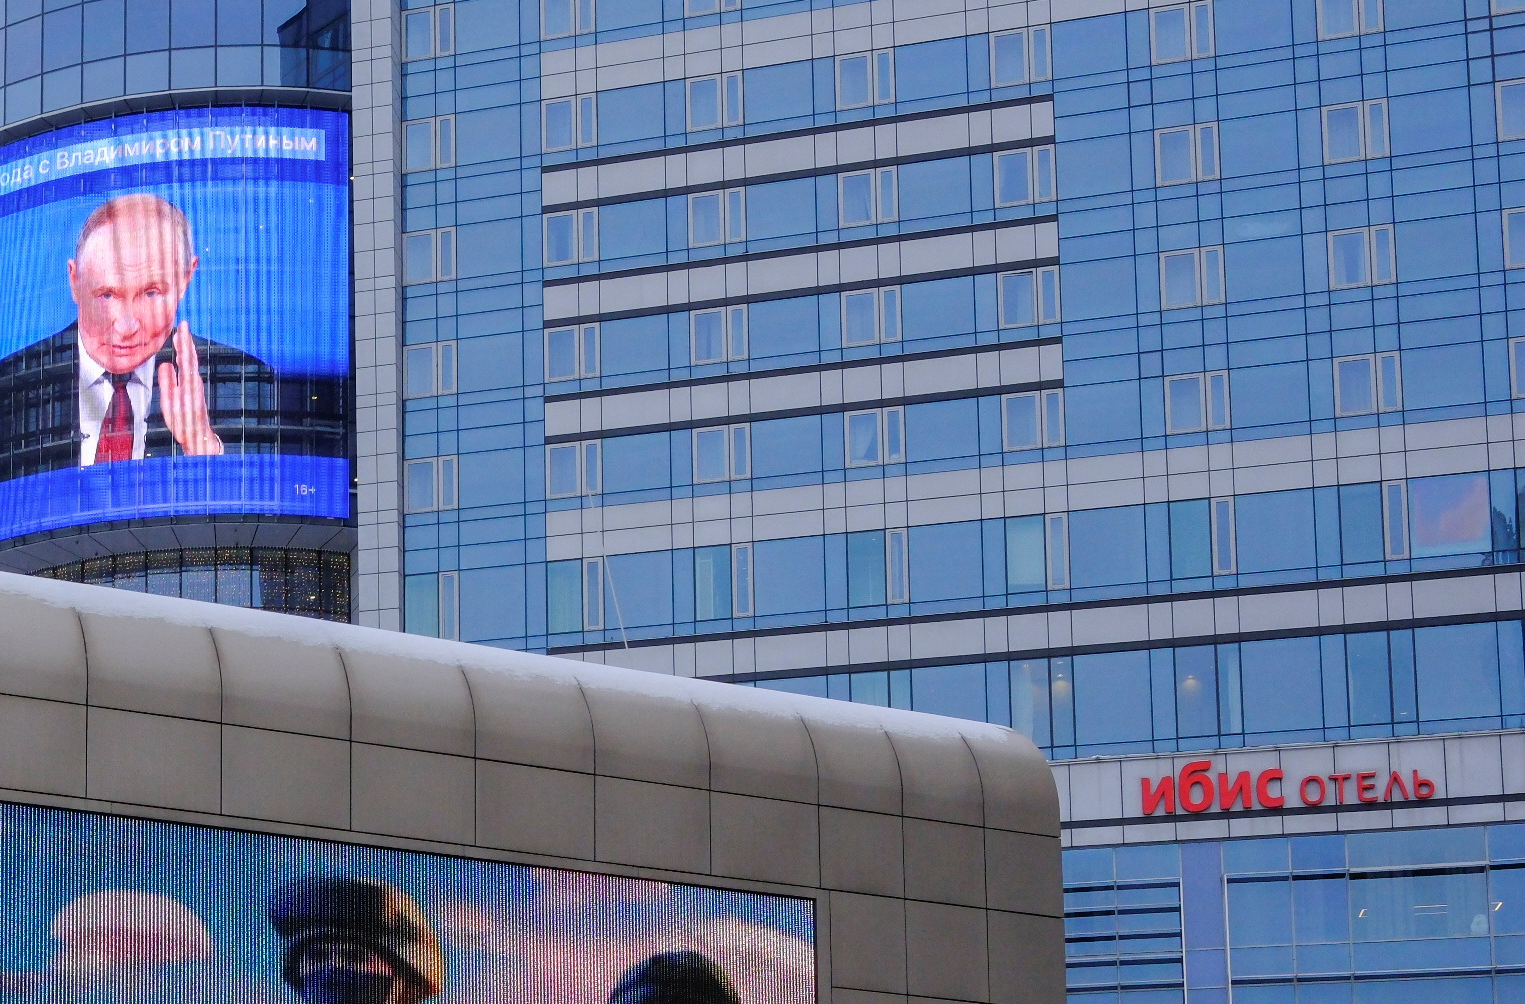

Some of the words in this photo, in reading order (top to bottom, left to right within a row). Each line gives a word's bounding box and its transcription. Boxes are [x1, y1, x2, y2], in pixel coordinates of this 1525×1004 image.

[38, 158, 50, 175] с
[56, 135, 202, 171] Владимиром
[209, 130, 318, 154] Путиным
[294, 484, 316, 496] 16+
[1141, 760, 1286, 816] ибис
[1299, 769, 1436, 806] ОТЕЛЬ
